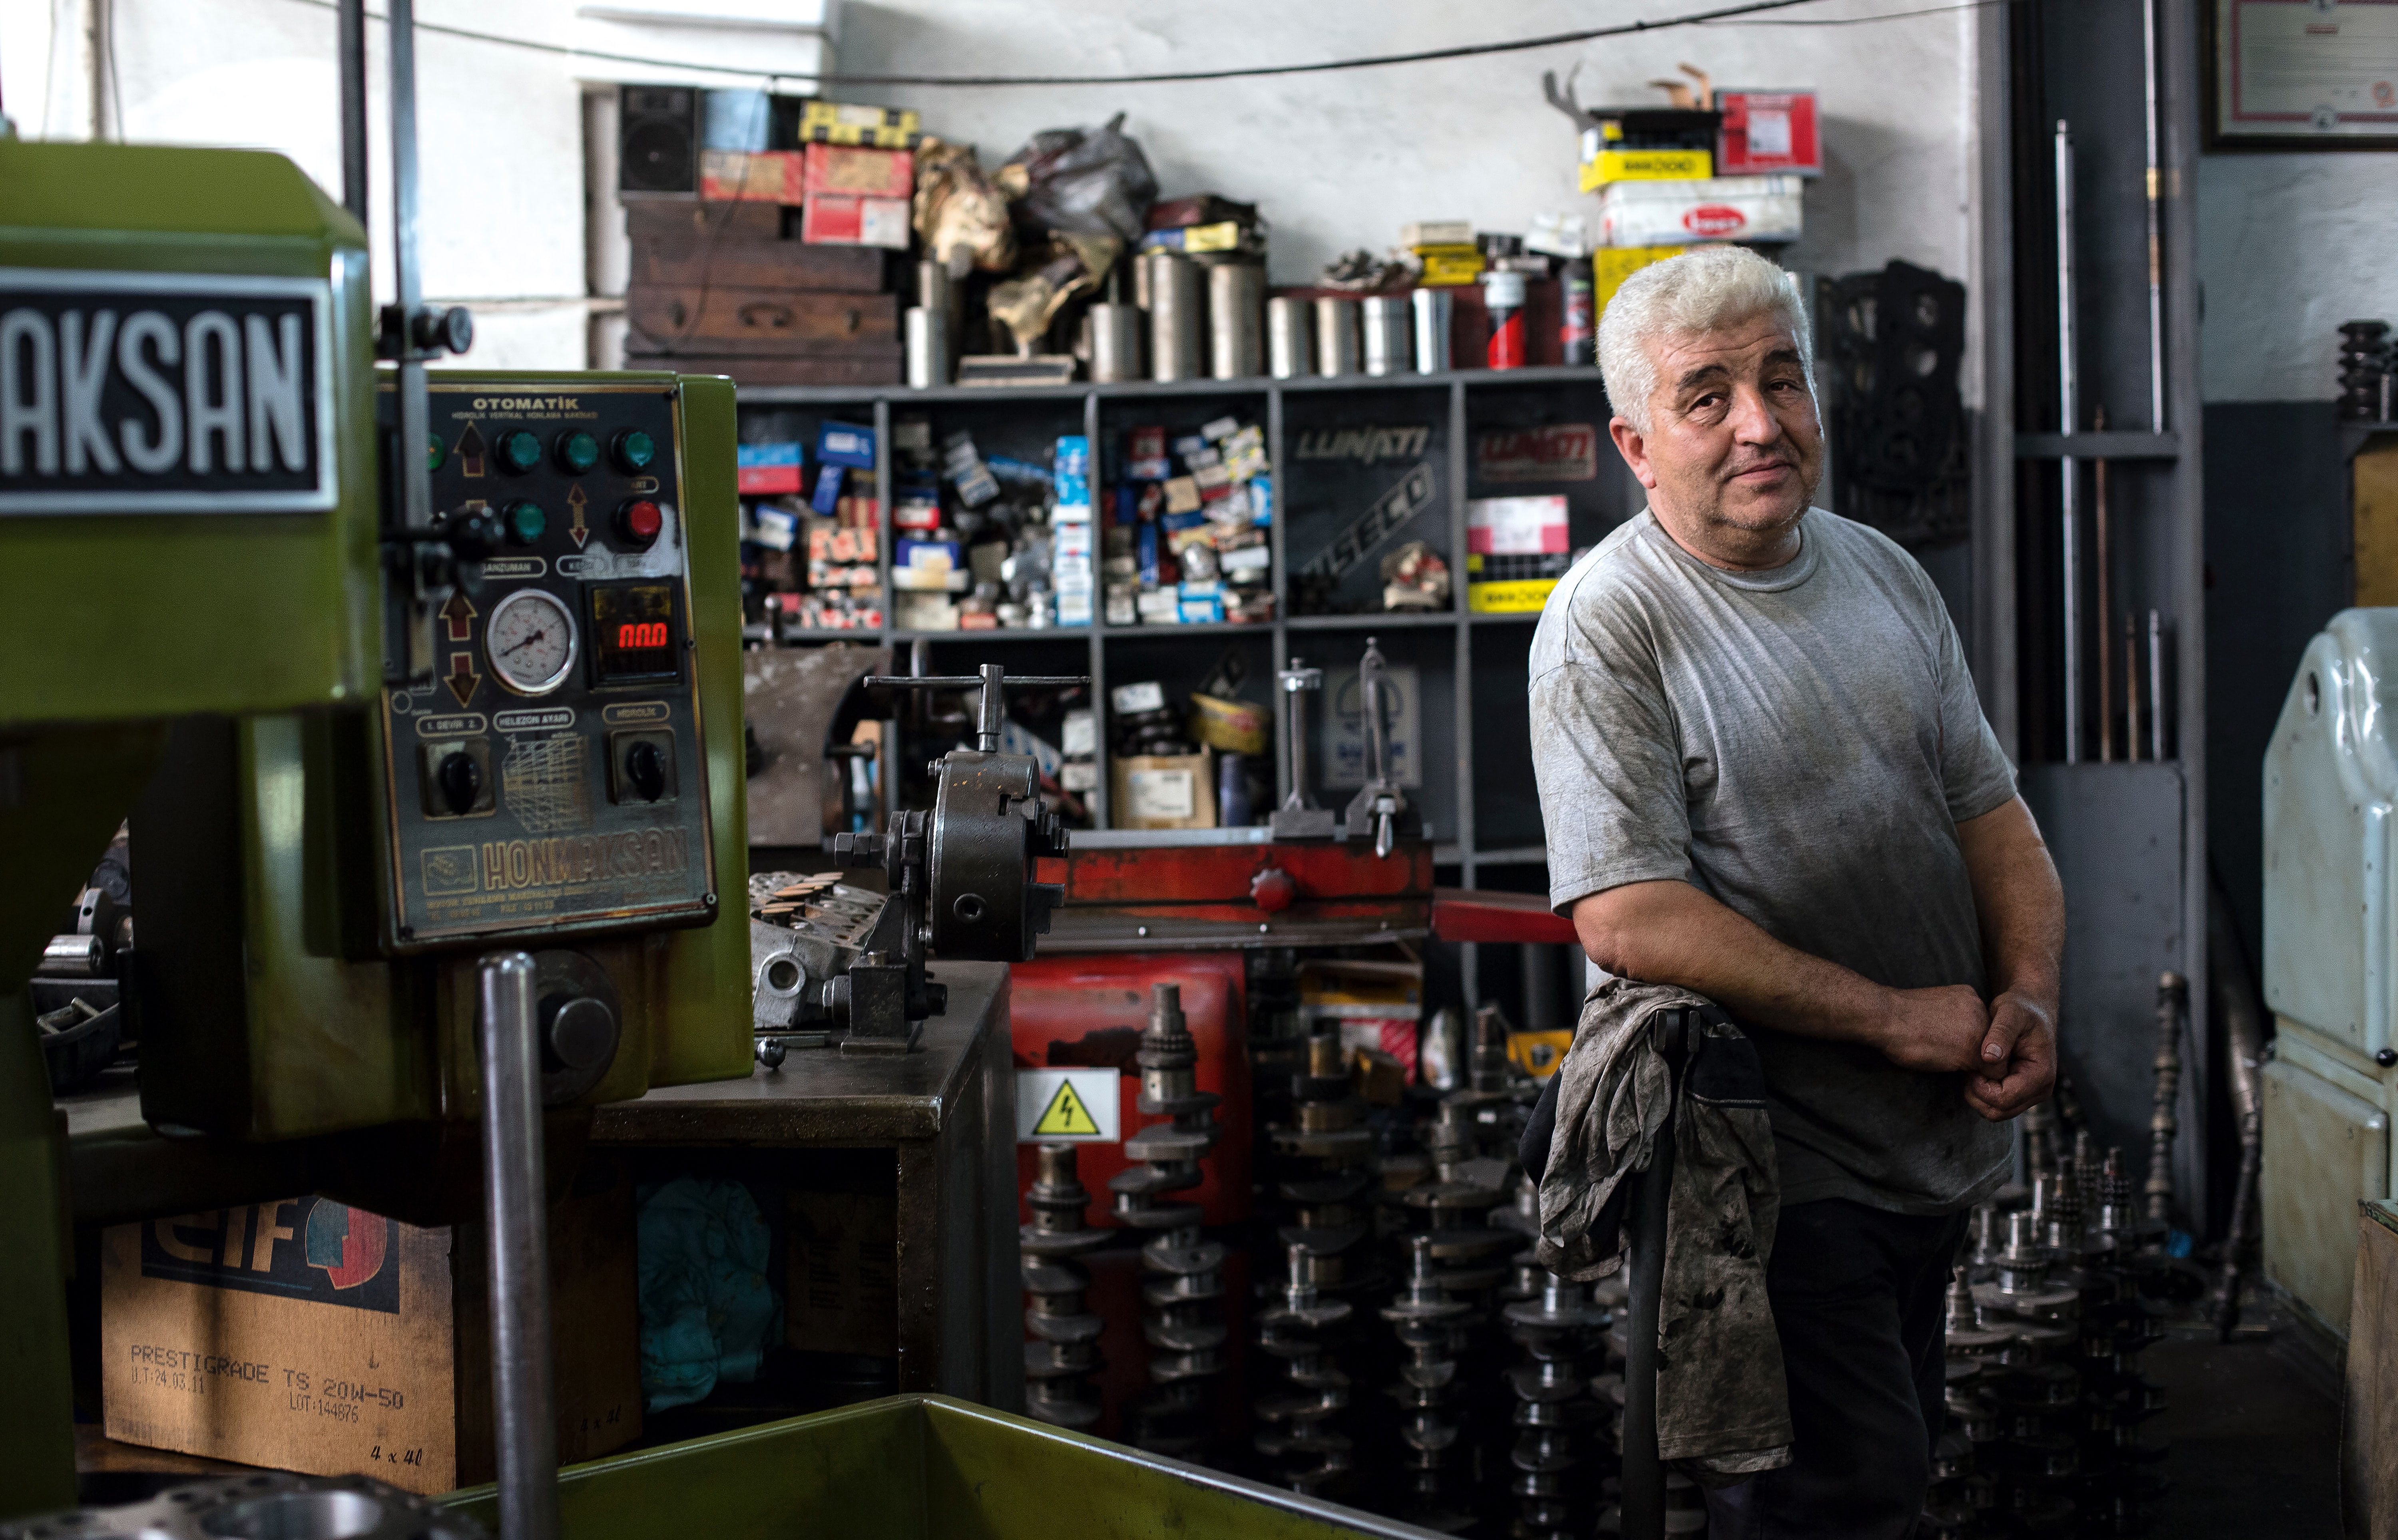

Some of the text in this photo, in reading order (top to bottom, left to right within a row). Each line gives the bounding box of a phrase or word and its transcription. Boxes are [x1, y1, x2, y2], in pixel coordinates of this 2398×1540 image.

[0, 307, 307, 477] AKSAN
[131, 1344, 404, 1410] PRESTIGRADE TS 20W-50
[370, 1445, 381, 1461] 4
